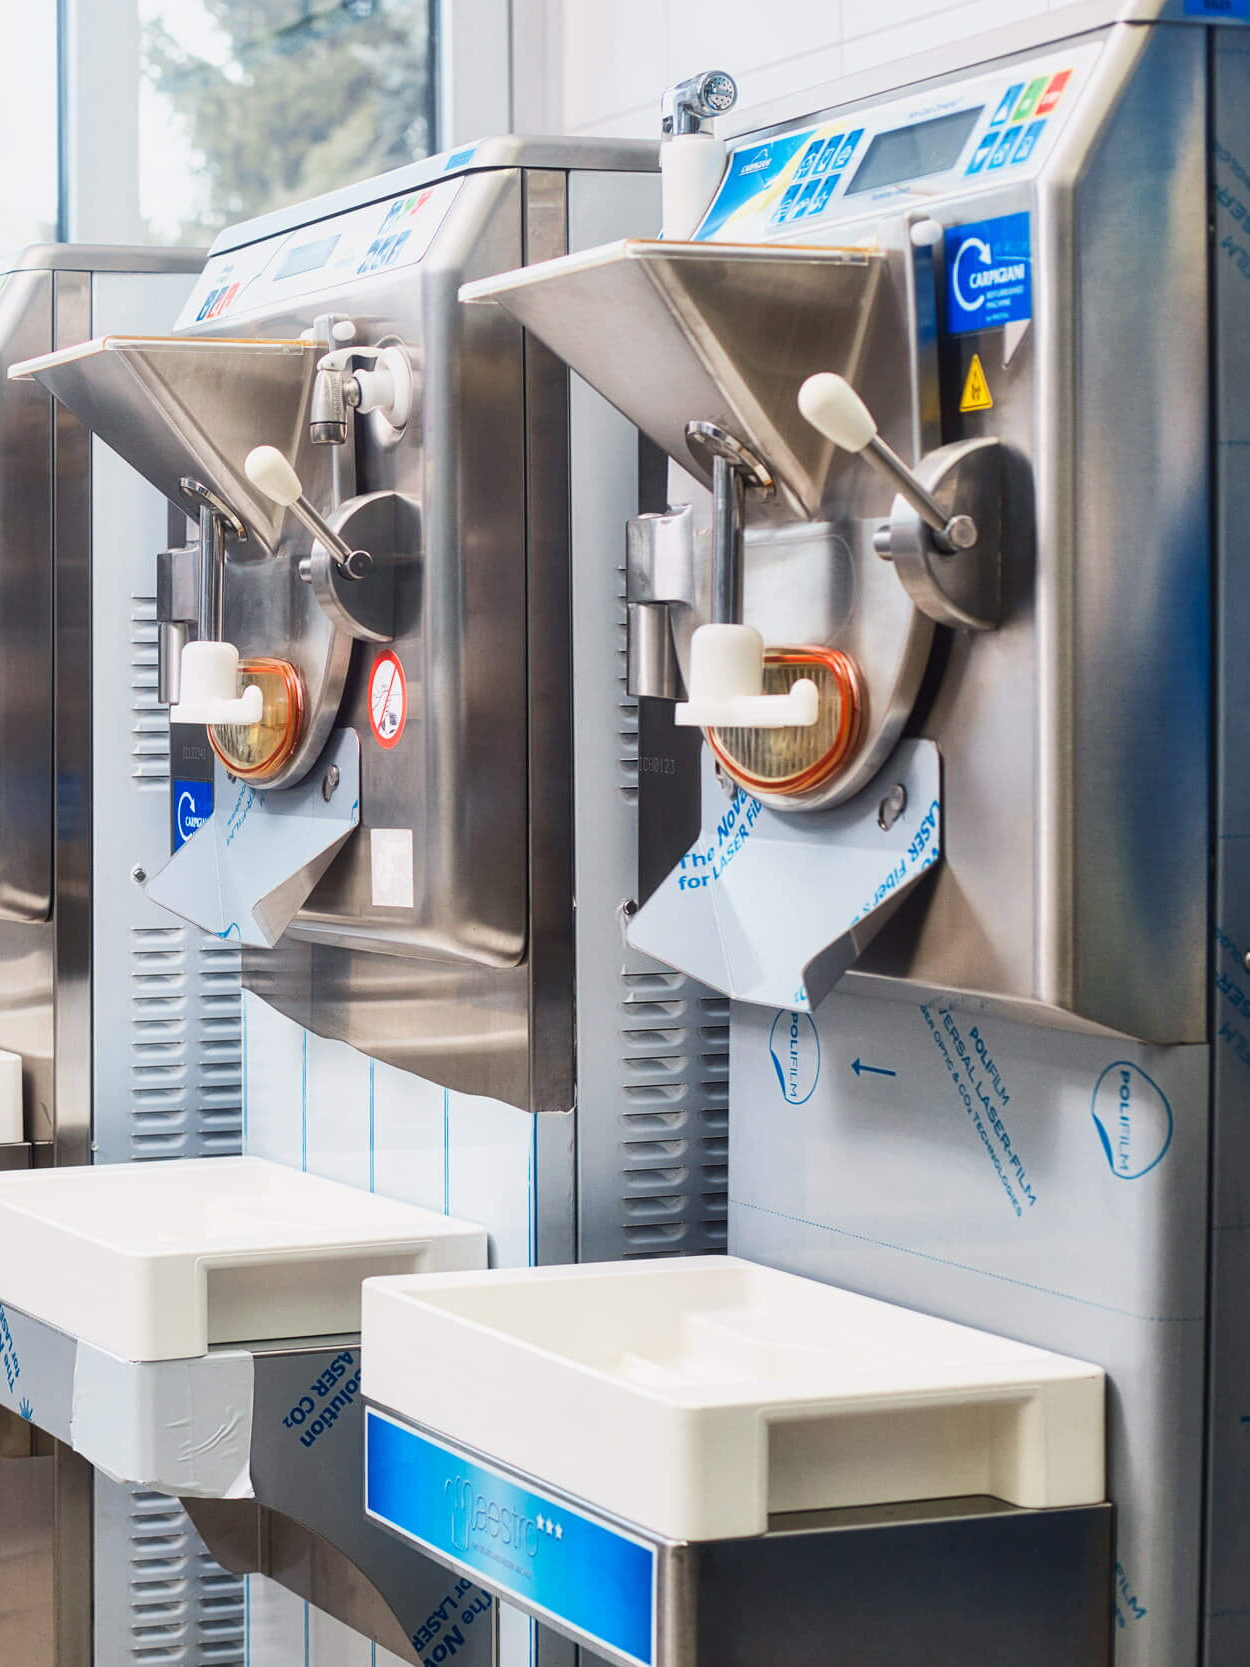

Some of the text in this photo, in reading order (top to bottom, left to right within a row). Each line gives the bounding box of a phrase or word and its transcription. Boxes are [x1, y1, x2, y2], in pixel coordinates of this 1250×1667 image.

[678, 874, 711, 891] for
[712, 823, 750, 880] LASER
[680, 847, 714, 869] The
[790, 1012, 799, 1097] POLIFILM
[969, 1026, 1011, 1107] POLIFILM
[1119, 1069, 1131, 1171] POLIFILM
[3, 1352, 15, 1393] The
[11, 1351, 20, 1378] for
[310, 1351, 354, 1397] ASER
